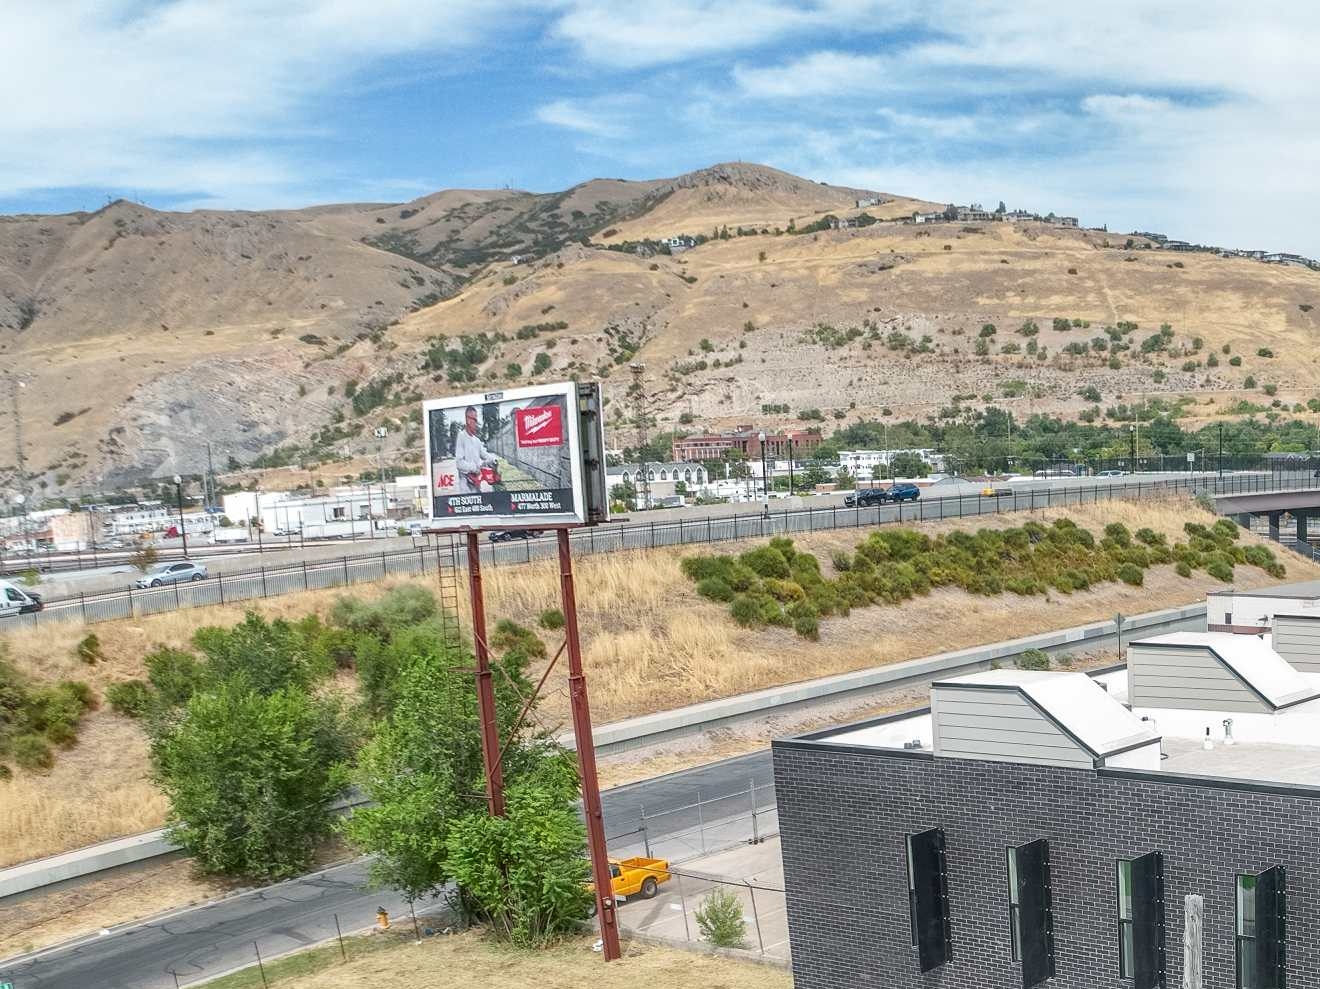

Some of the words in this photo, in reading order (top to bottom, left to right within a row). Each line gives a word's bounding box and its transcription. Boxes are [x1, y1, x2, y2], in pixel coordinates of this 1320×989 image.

[437, 474, 455, 488] ACE
[461, 495, 482, 505] SOUTH
[511, 492, 553, 502] MARMALADE
